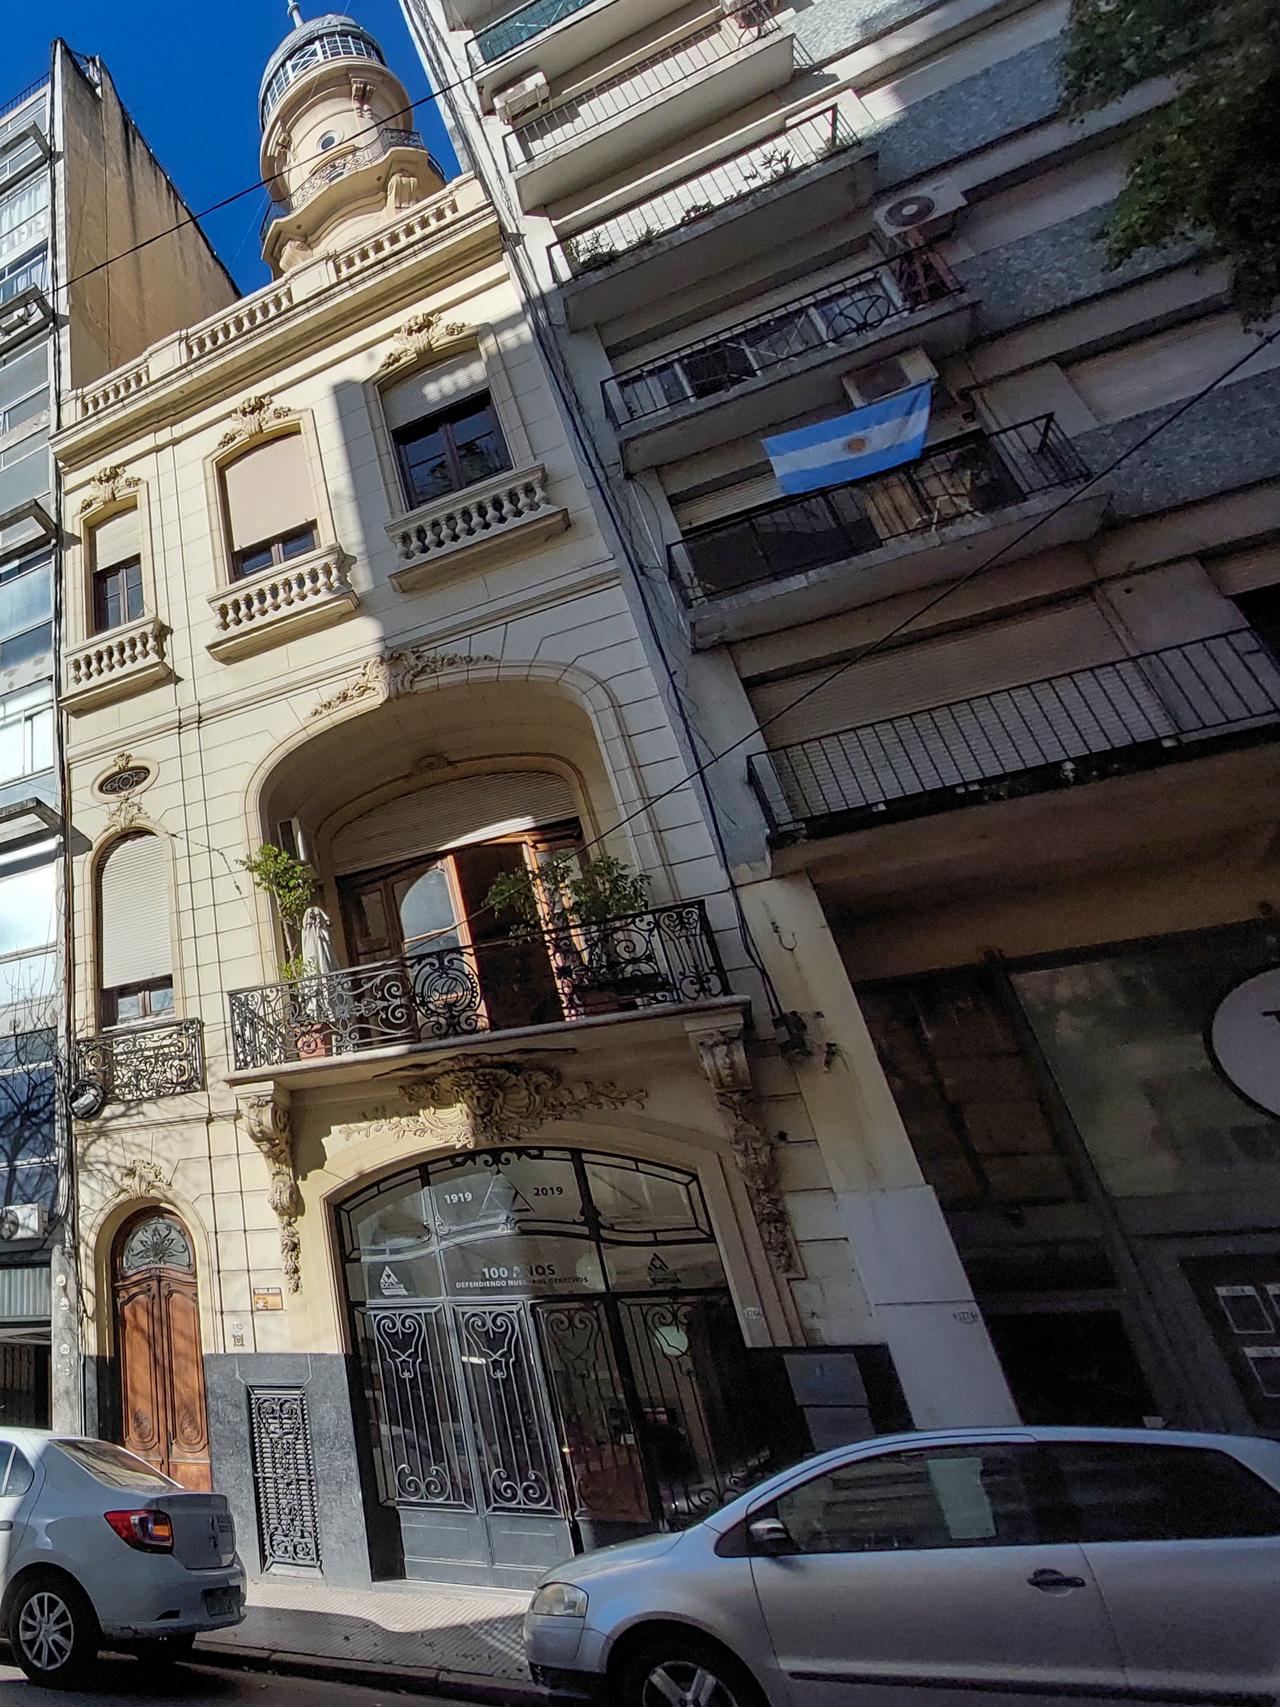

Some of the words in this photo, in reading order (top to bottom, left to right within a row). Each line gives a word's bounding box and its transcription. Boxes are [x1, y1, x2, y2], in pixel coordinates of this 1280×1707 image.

[533, 1186, 564, 1197] 2019
[444, 1192, 473, 1204] 1919
[482, 1267, 508, 1279] 100
[456, 1280, 506, 1288] DEFENDIENDO
